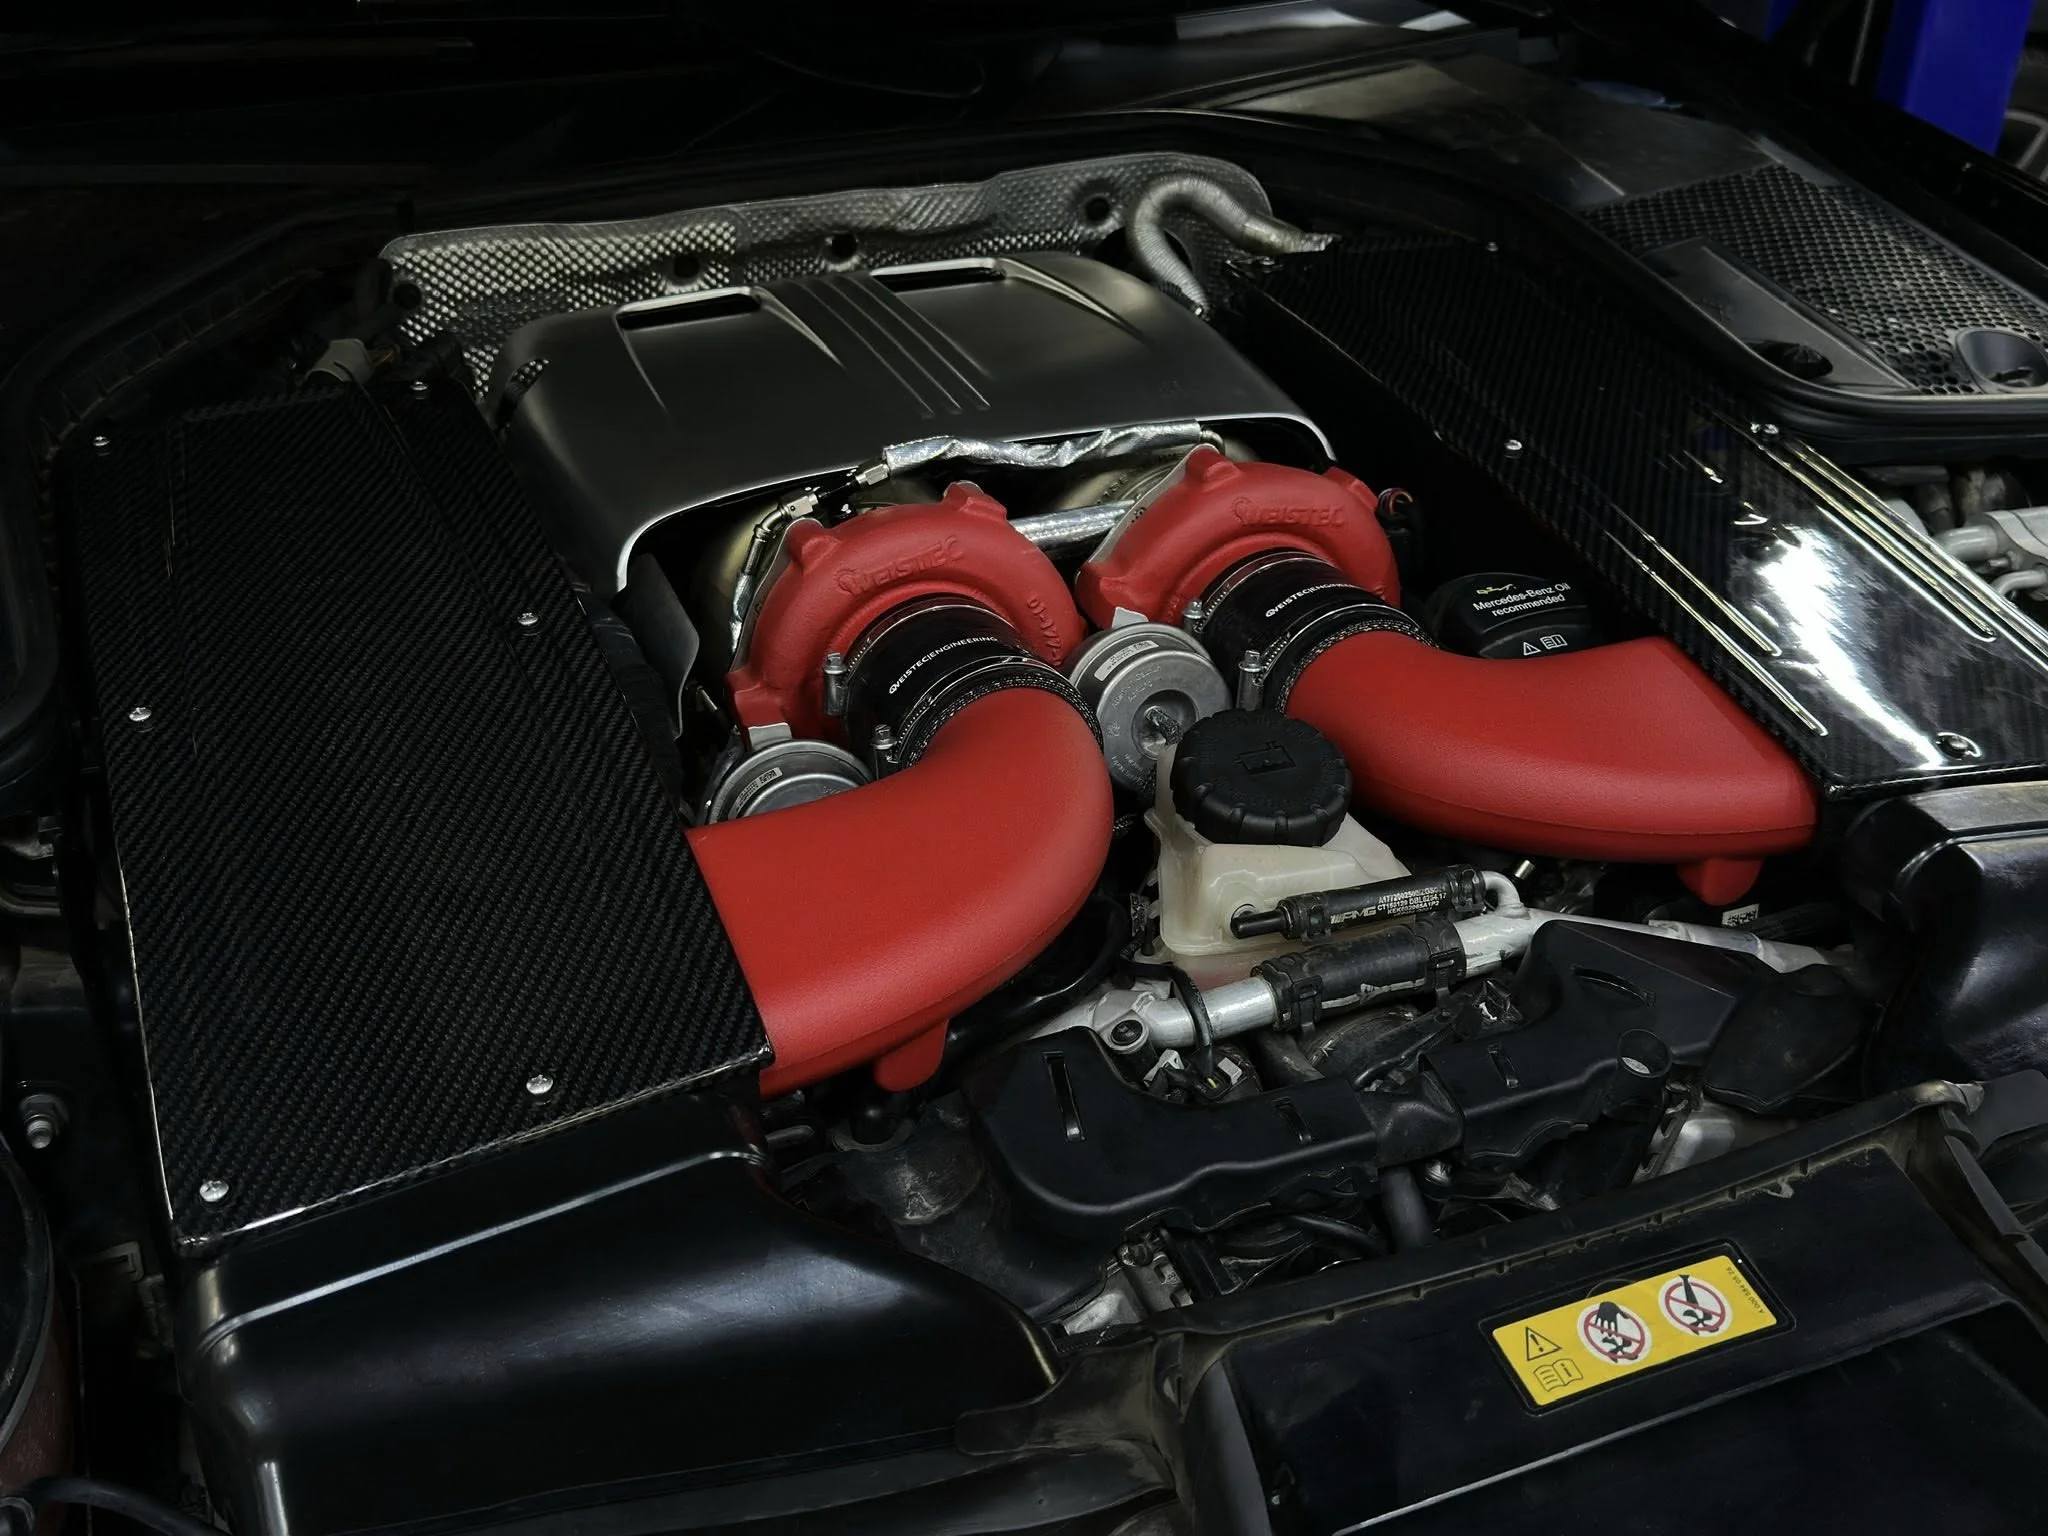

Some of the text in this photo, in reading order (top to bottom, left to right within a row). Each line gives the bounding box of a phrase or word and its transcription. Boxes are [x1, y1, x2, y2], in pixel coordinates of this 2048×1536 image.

[1473, 582, 1571, 611] Mercedes-Benz Oil
[1492, 593, 1566, 617] recommended
